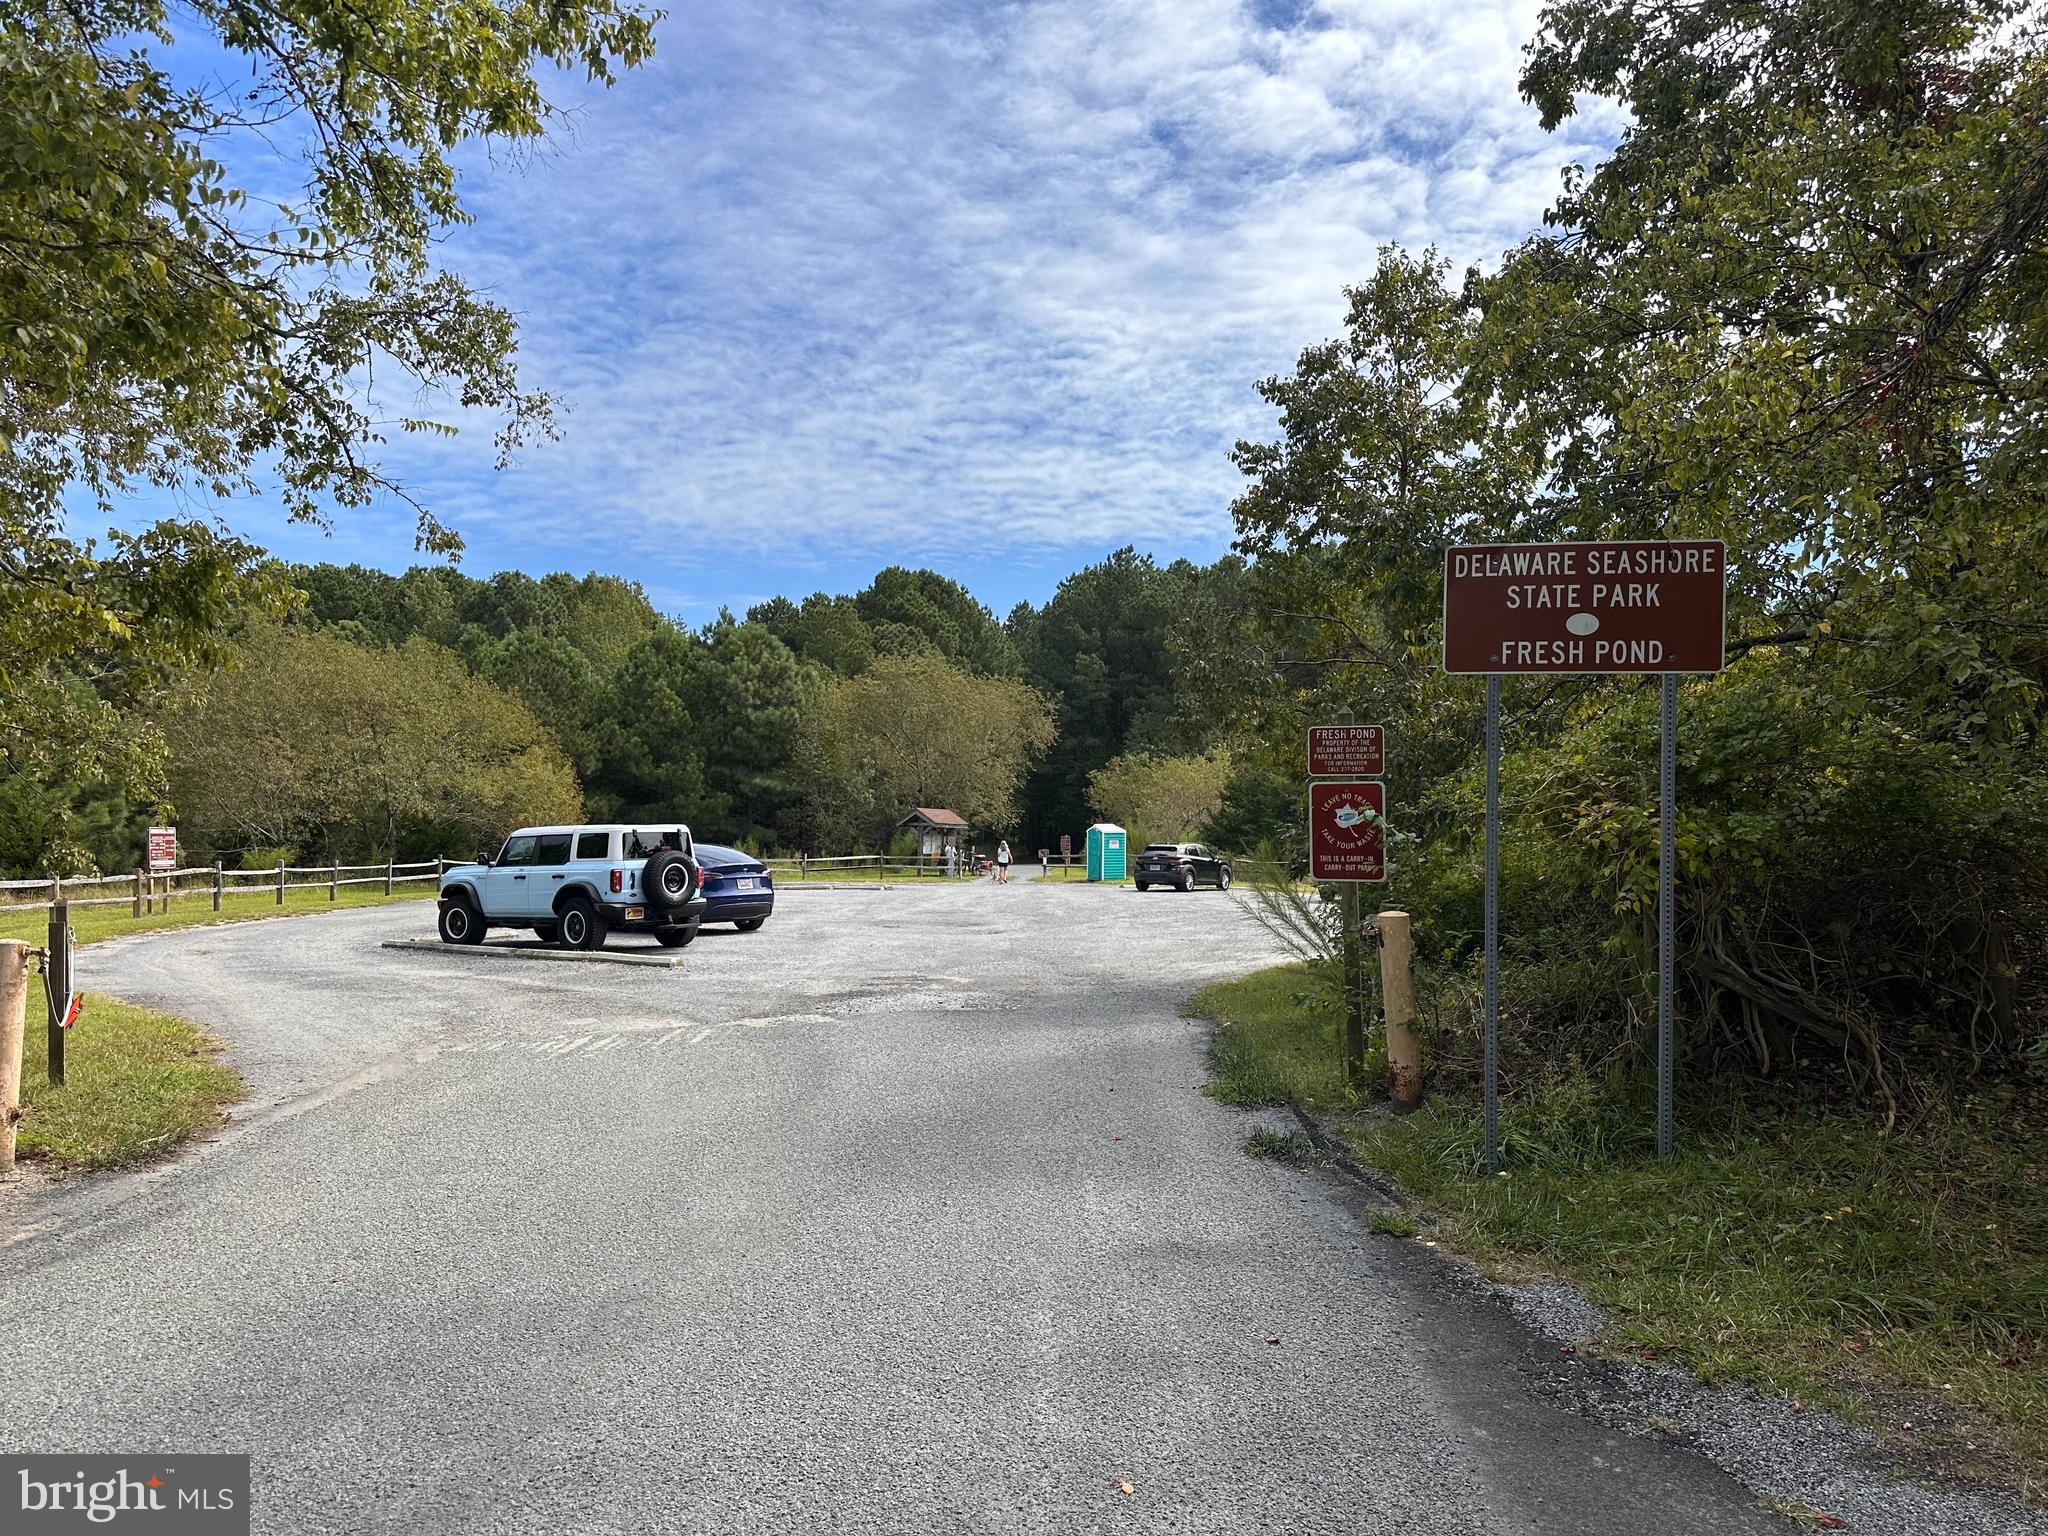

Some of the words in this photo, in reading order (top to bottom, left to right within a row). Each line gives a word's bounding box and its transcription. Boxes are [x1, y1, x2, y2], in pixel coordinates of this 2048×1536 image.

[1455, 551, 1576, 577] DELAWARE
[1587, 548, 1715, 575] SEASHORE
[1506, 584, 1581, 609] STATE
[1592, 583, 1660, 608] PARK
[1502, 641, 1583, 665] FRESH
[1595, 640, 1663, 664] POND
[1316, 729, 1347, 739] FRESH
[1350, 728, 1376, 739] POND
[1321, 794, 1341, 812] LEAVE
[1321, 828, 1336, 845] TAKE
[1336, 840, 1355, 849] YOUR
[1356, 827, 1376, 847] WASTE
